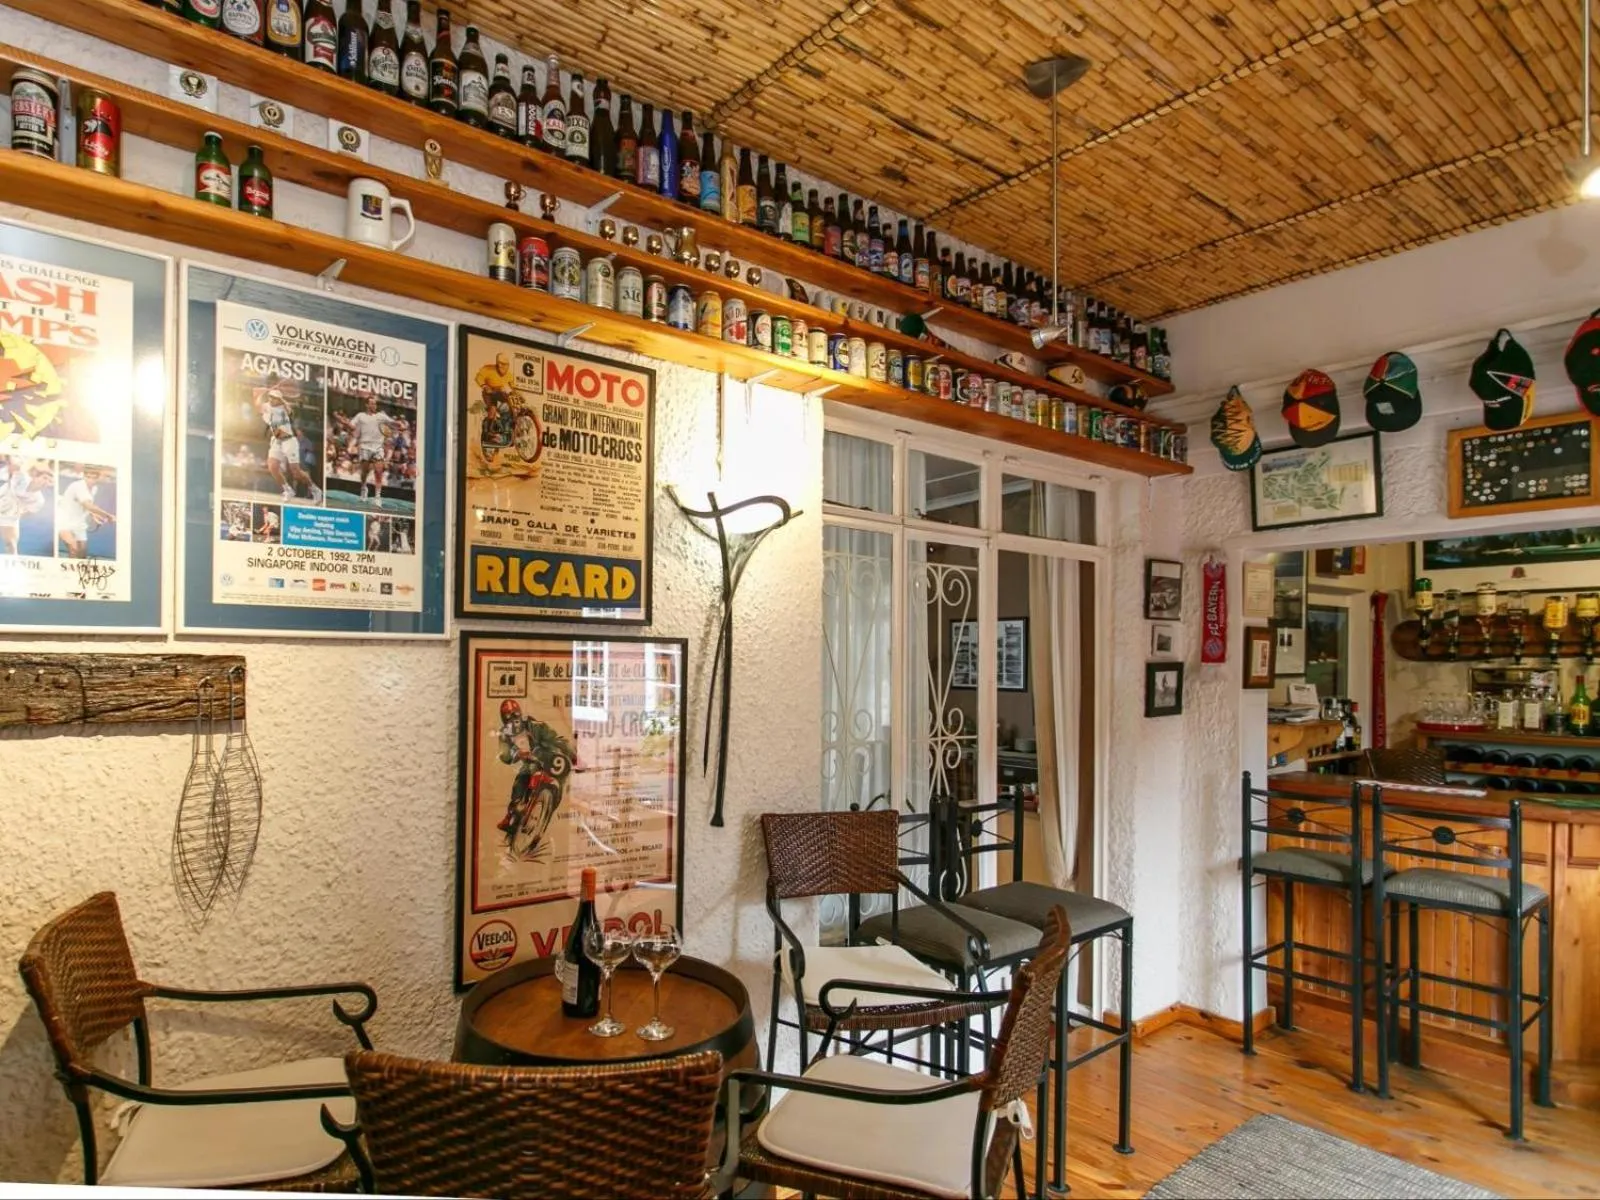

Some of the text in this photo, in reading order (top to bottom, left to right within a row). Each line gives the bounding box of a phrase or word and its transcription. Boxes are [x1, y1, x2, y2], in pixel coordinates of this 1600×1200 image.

[19, 264, 100, 288] CHALLENGE
[272, 338, 310, 350] SUPER
[313, 346, 376, 364] CHALLENGE
[276, 323, 376, 354] VOLKSWAGEN
[240, 353, 310, 382] AGASSI
[332, 369, 413, 400] McENROE
[522, 362, 534, 378] 6
[546, 360, 645, 408] MOTO
[542, 403, 569, 427] GRAND
[570, 409, 588, 430] PRIX
[542, 426, 642, 464] de MOTO-CROSS
[526, 520, 558, 530] GALA
[564, 524, 579, 534] DE
[247, 558, 393, 576] SINGAPORE INDOOR STADIUM
[267, 546, 273, 556] 2
[356, 554, 376, 564] 7PM
[476, 554, 636, 600] RICARD
[1207, 581, 1220, 622] BAYERN
[532, 662, 551, 678] Ville
[477, 930, 514, 951] VEEDOL
